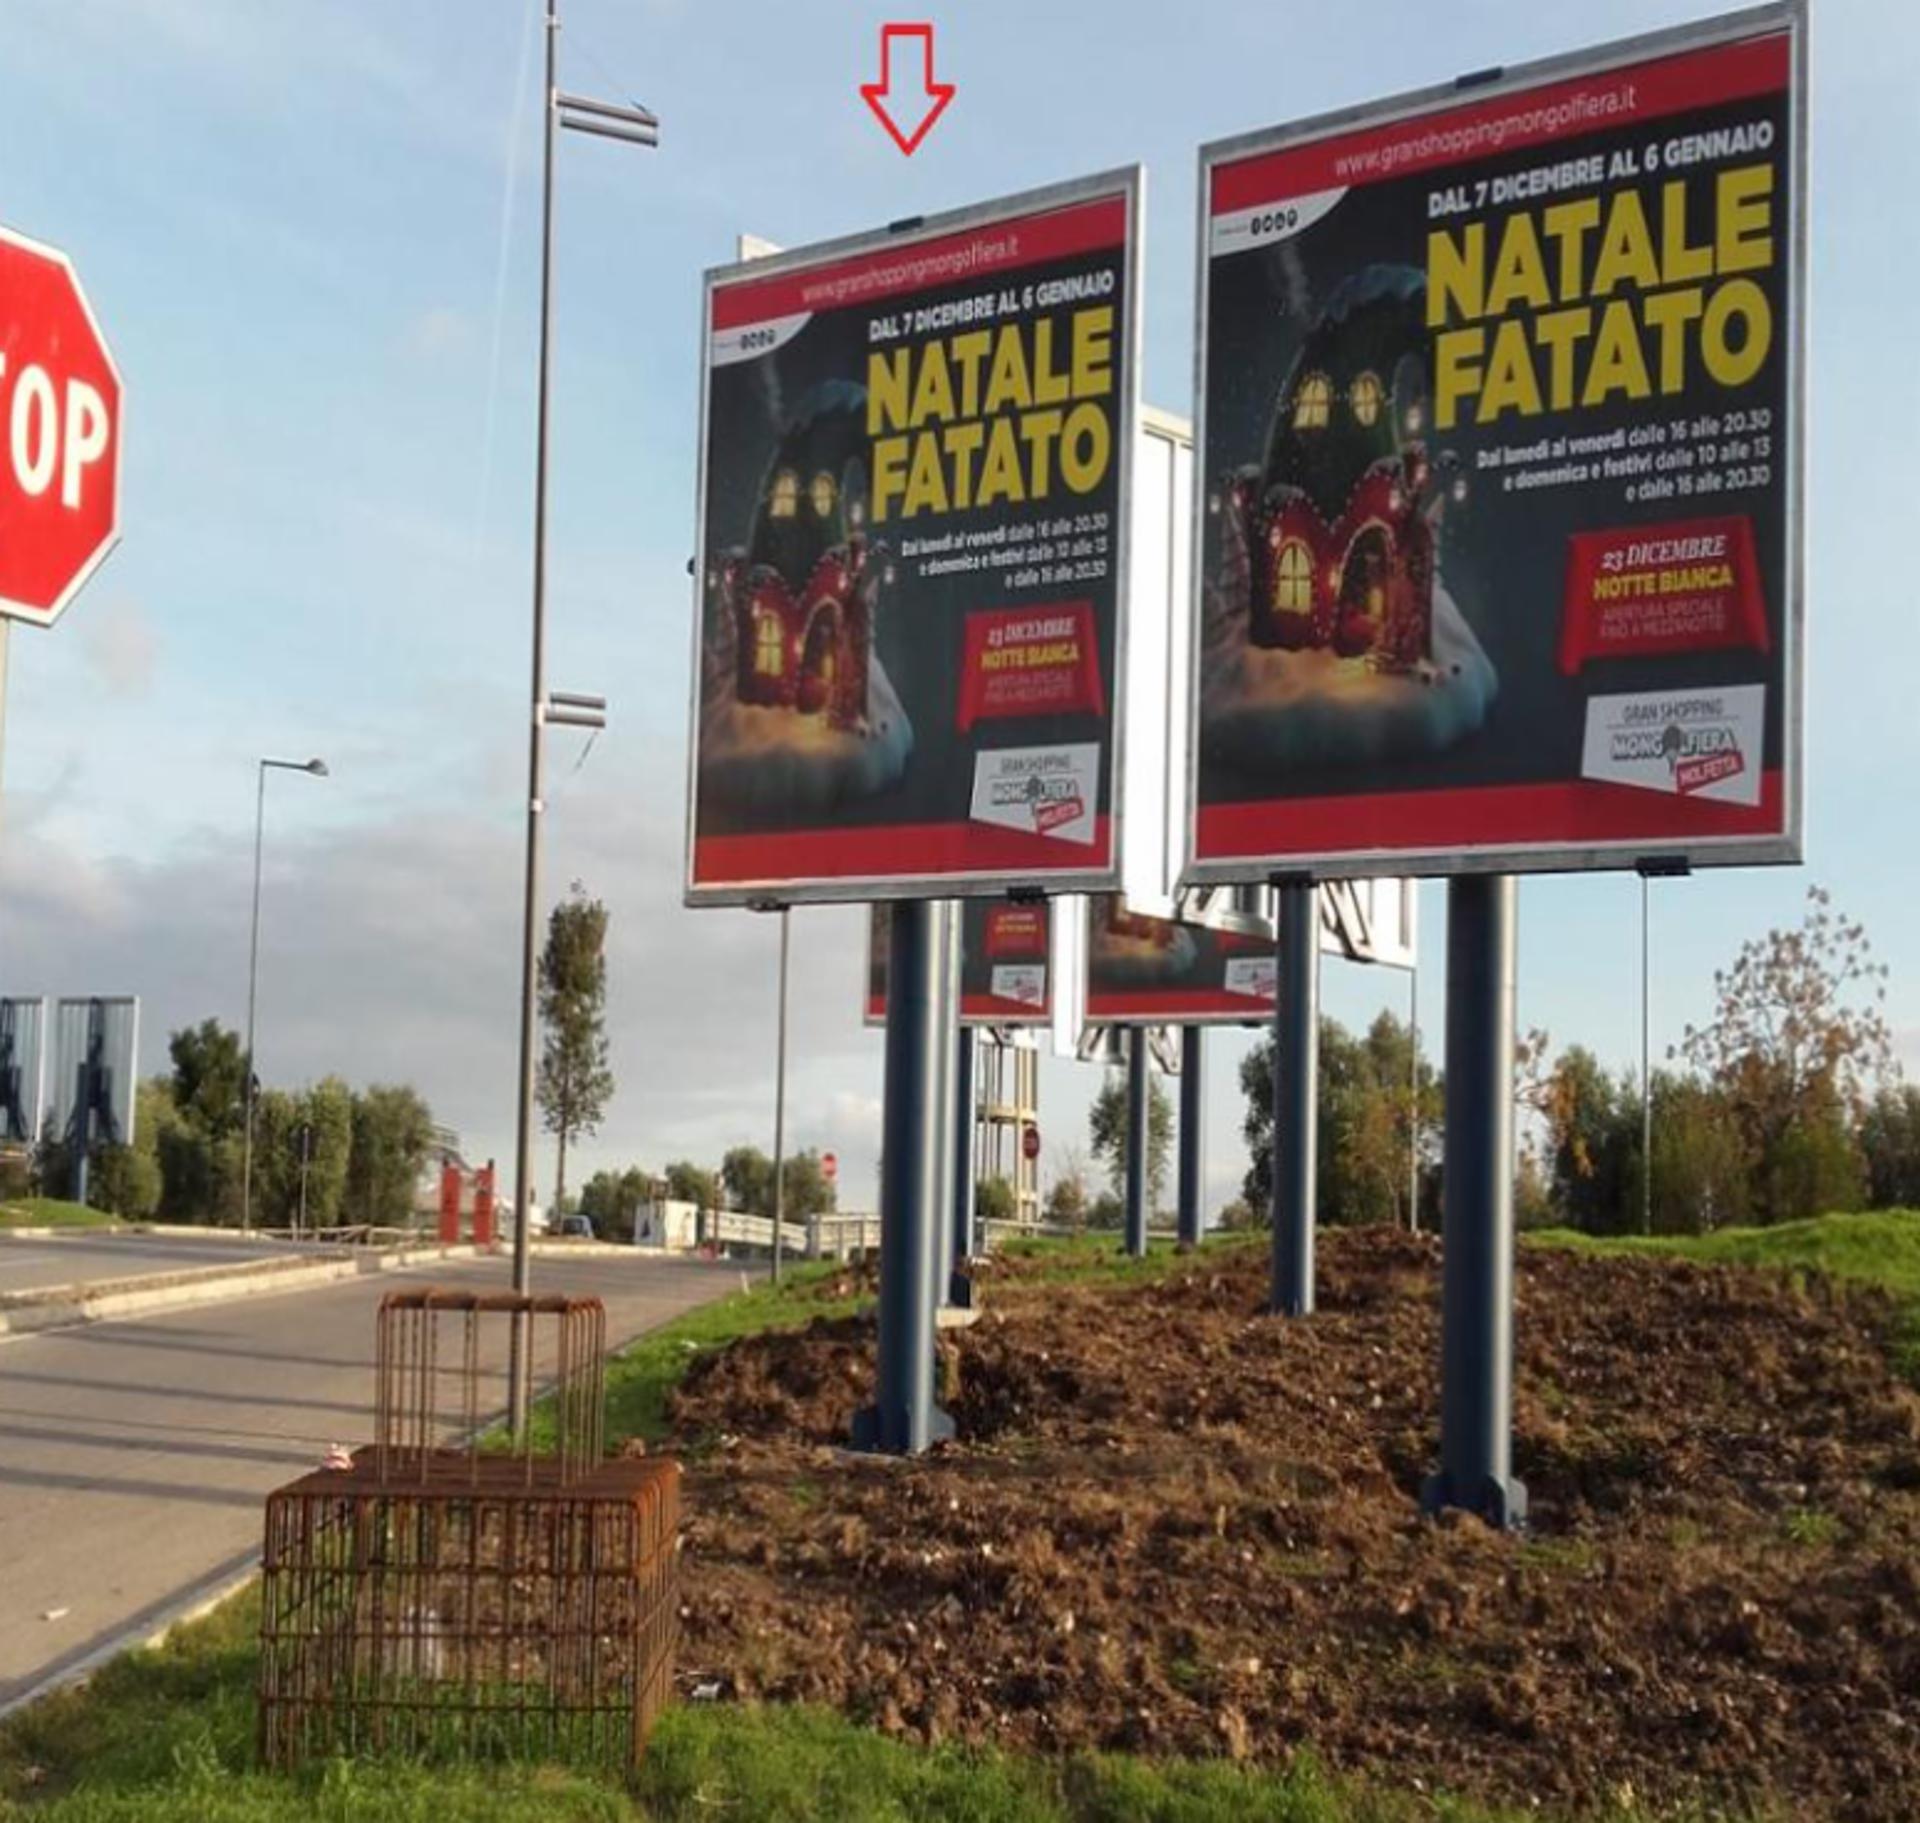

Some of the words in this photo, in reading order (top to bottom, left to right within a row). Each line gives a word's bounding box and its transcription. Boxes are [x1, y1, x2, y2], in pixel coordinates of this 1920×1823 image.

[1335, 85, 1637, 178] www.granshoppingmongolfiera.it
[1428, 187, 1470, 218] DAL
[1474, 183, 1488, 208] 7
[1491, 155, 1605, 204] DICEMBRE
[1608, 147, 1640, 177] AL
[1644, 140, 1660, 170] 6
[1664, 120, 1774, 167] GENNAIO
[1426, 164, 1774, 327] NATALE
[868, 318, 899, 342] DAL
[903, 315, 913, 334] 7
[914, 293, 995, 331] DICEMBRE
[998, 289, 1019, 312] AL
[1022, 287, 1034, 310] 6
[1036, 270, 1115, 306] GENNAIO
[867, 306, 1114, 436] NATALE
[1435, 278, 1772, 429] FATATO
[0, 352, 109, 512] OP
[871, 401, 1111, 522] FATATO
[1477, 447, 1503, 468] Dal
[1552, 437, 1567, 457] al
[1628, 423, 1665, 447] dalle
[1669, 420, 1686, 440] 16
[1691, 415, 1720, 436] alle
[1723, 408, 1772, 434] 20.30
[1515, 463, 1588, 489] domenica
[1604, 450, 1653, 476] festivi
[1655, 445, 1694, 470] dalle
[1697, 444, 1717, 464] 10
[1719, 439, 1749, 461] alle
[1753, 435, 1771, 457] 13
[1639, 475, 1674, 499] dalle
[1695, 470, 1722, 491] alle
[1725, 464, 1771, 489] 20.30
[1593, 571, 1656, 600] NOTTE
[1659, 564, 1734, 592] BIANCA
[1601, 550, 1624, 572] 23
[1626, 535, 1728, 565] DICEMBRE
[1623, 703, 1658, 723] GRAN
[1660, 698, 1724, 722] SHOPPING
[1678, 754, 1740, 786] MOLFETTA
